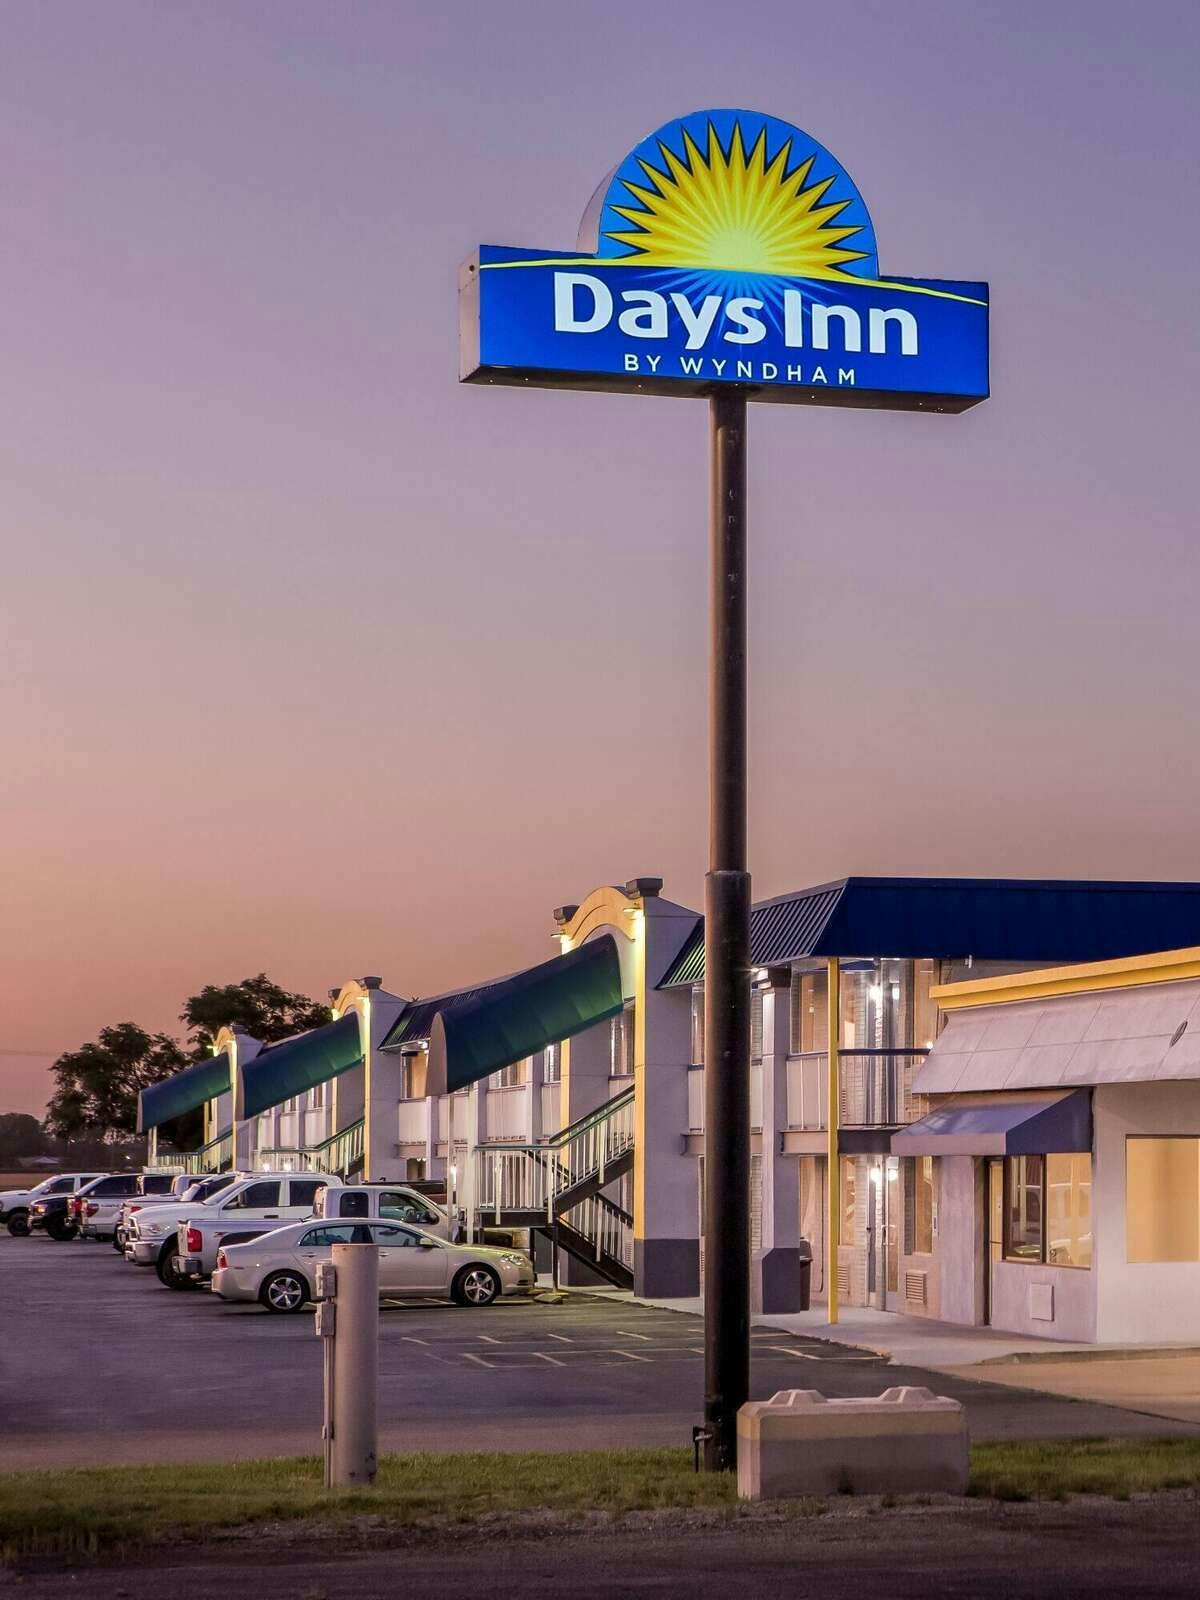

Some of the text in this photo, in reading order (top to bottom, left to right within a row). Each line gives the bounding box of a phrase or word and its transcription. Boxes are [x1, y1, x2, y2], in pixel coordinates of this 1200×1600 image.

[553, 271, 919, 356] Days Inn
[624, 353, 856, 386] BY WYNDHAM
